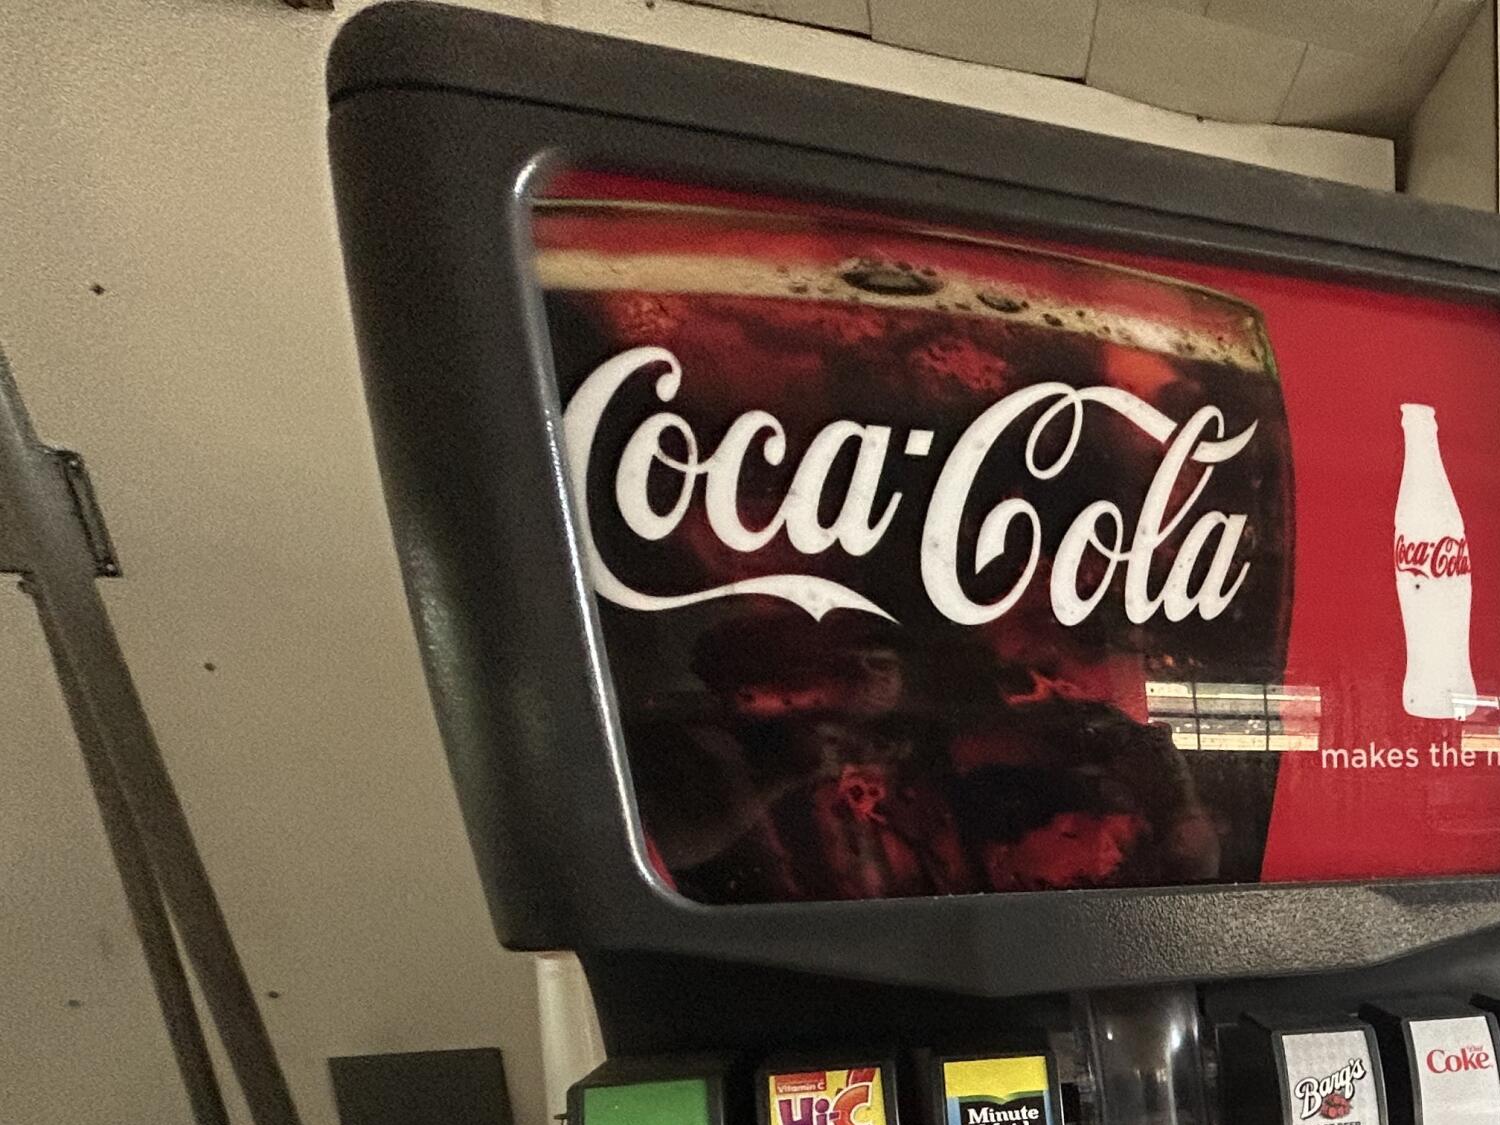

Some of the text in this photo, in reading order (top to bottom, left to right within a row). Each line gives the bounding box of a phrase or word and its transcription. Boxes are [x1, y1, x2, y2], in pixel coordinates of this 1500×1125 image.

[563, 346, 1258, 626] Coca-Cola
[1396, 535, 1471, 579] Coca-Cola
[1321, 741, 1419, 768] makes
[1429, 741, 1475, 767] the
[1426, 1048, 1490, 1074] Coke
[776, 1082, 825, 1094] Vitamin C
[1294, 1058, 1366, 1120] Barq's
[967, 1105, 1040, 1125] Minute
